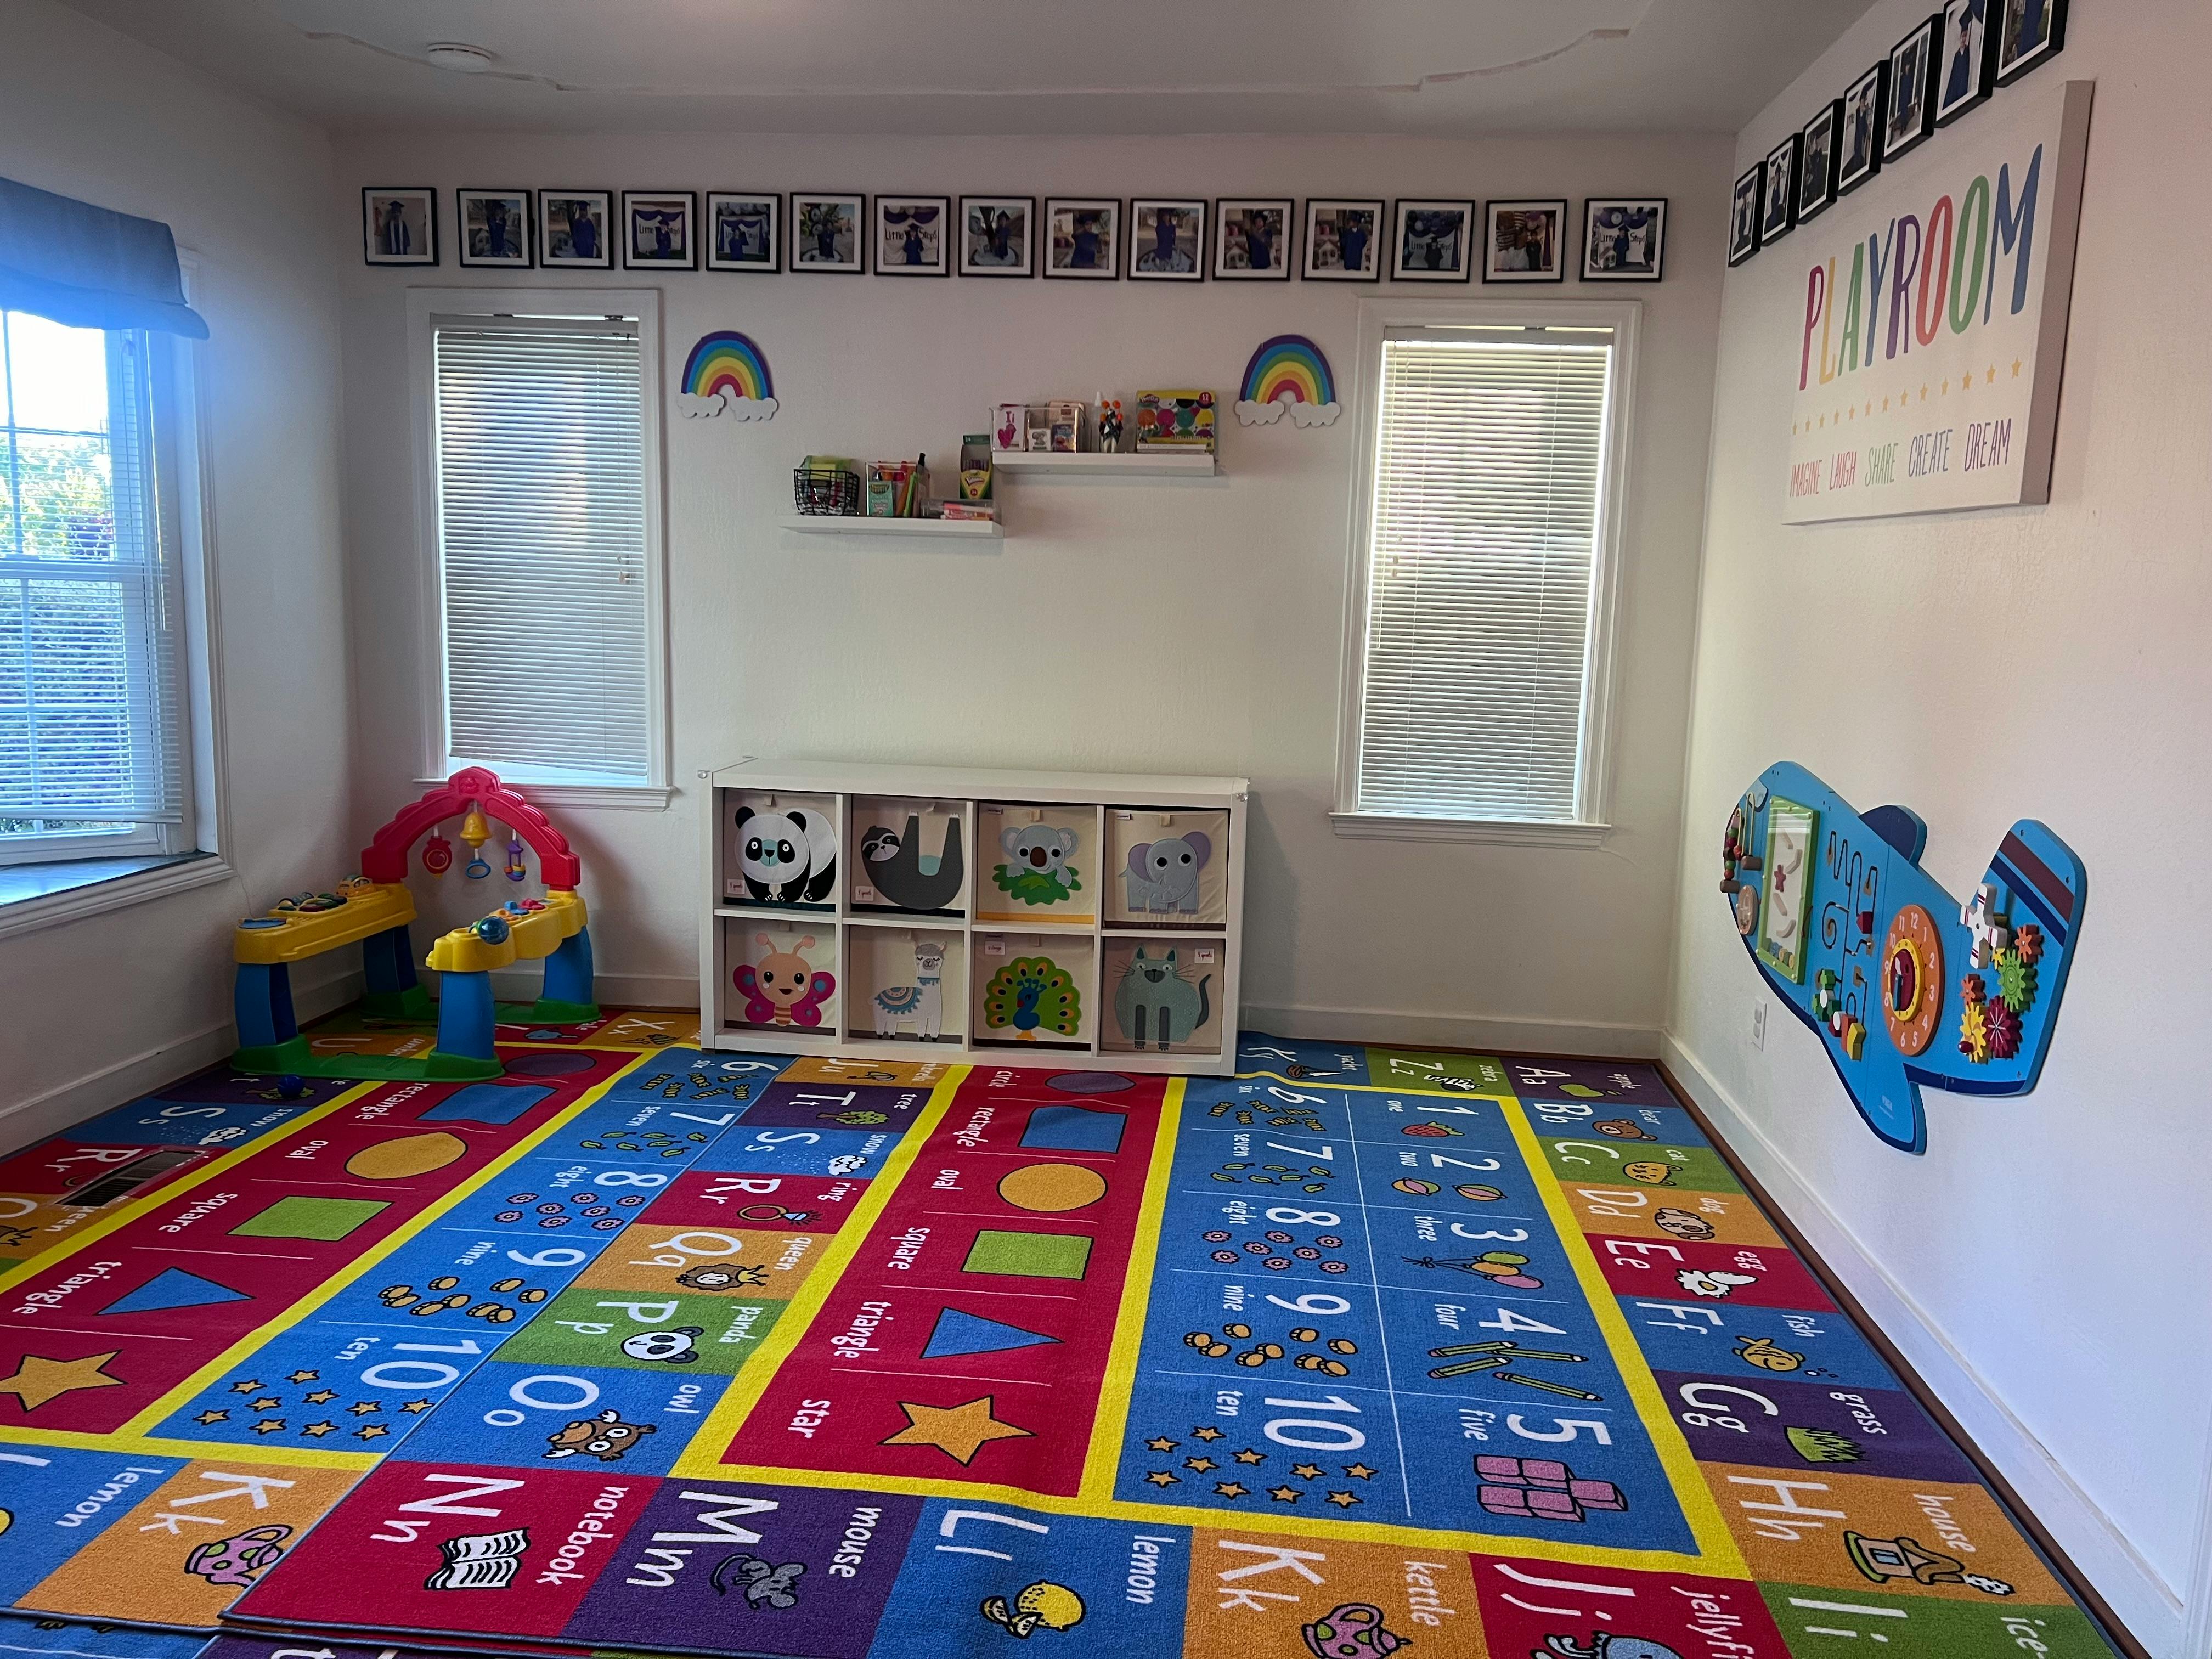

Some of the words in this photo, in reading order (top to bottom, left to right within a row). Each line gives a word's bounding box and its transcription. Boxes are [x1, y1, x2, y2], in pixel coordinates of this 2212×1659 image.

[1799, 143, 2043, 391] PLAYROOM
[1790, 459, 1822, 498] IMAGINE
[1829, 450, 1858, 491] LAUGH
[1865, 443, 1899, 487] SHARE
[1909, 428, 1953, 478] CREATE
[1963, 417, 2012, 472] DREAM
[1899, 915, 1905, 932] 11
[1911, 912, 1918, 929] 12
[1889, 932, 1896, 949] 10
[1923, 926, 1927, 942] 1
[1884, 960, 1889, 975] 9
[1929, 952, 1935, 969] 2
[1884, 991, 1889, 1007] 8
[1929, 984, 1935, 1001] 3
[1890, 1017, 1895, 1032] 7
[1922, 1014, 1928, 1031] 4
[1900, 1032, 1905, 1047] 6
[1912, 1031, 1918, 1047] 5
[691, 1059, 714, 1070] six
[721, 1060, 779, 1072] 6
[1479, 1065, 1503, 1082] zebra
[988, 1070, 1023, 1088] circle
[1238, 1085, 1261, 1094] six
[1607, 1073, 1642, 1090] apple
[356, 1082, 430, 1121] rectangle
[894, 1093, 918, 1109] tree
[1268, 1086, 1328, 1104] 6
[1387, 1099, 1404, 1113] one
[250, 1108, 294, 1127] snow
[625, 1105, 661, 1127] seven
[670, 1111, 735, 1127] 7
[1416, 1105, 1479, 1116] 1
[1638, 1108, 1661, 1125] bear
[952, 1106, 995, 1148] rectangle
[285, 1139, 329, 1160] oval
[860, 1133, 888, 1155] snow
[1232, 1132, 1250, 1157] seven
[1266, 1141, 1334, 1161] 7
[1666, 1148, 1689, 1162] cat
[1398, 1151, 1418, 1167] two
[1430, 1153, 1501, 1171] 2
[549, 1165, 593, 1189] eight
[594, 1170, 668, 1188] 8
[931, 1169, 964, 1190] oval
[817, 1181, 858, 1203] ring
[159, 1192, 239, 1233] square
[1221, 1200, 1248, 1226] eight
[1265, 1207, 1341, 1227] 8
[1699, 1197, 1729, 1215] dog
[1413, 1215, 1444, 1243] three
[1450, 1222, 1529, 1242] 3
[454, 1240, 496, 1267] nine
[507, 1248, 586, 1267] 9
[773, 1236, 812, 1272] queen
[887, 1227, 931, 1271] square
[1733, 1250, 1768, 1272] egg
[12, 1261, 122, 1314] triangle
[1221, 1284, 1245, 1312] nine
[1265, 1293, 1352, 1317] 9
[718, 1305, 764, 1345] panda
[1433, 1302, 1466, 1331] four
[1477, 1306, 1568, 1335] 4
[1782, 1313, 1826, 1339] fish
[831, 1300, 894, 1359] triangle
[334, 1336, 382, 1361] ten
[360, 1339, 483, 1390] 10
[662, 1383, 702, 1414] owl
[1215, 1390, 1244, 1417] ten
[787, 1398, 832, 1440] star
[1262, 1393, 1367, 1451] 10
[1458, 1407, 1489, 1442] five
[1829, 1391, 1887, 1436] grass
[1505, 1413, 1612, 1447] 5
[55, 1465, 165, 1528] lemon
[1913, 1493, 1975, 1553] house
[535, 1485, 630, 1586] notebook
[828, 1506, 882, 1579] mouse
[1126, 1534, 1177, 1605] lemon
[1403, 1560, 1457, 1627] kettle
